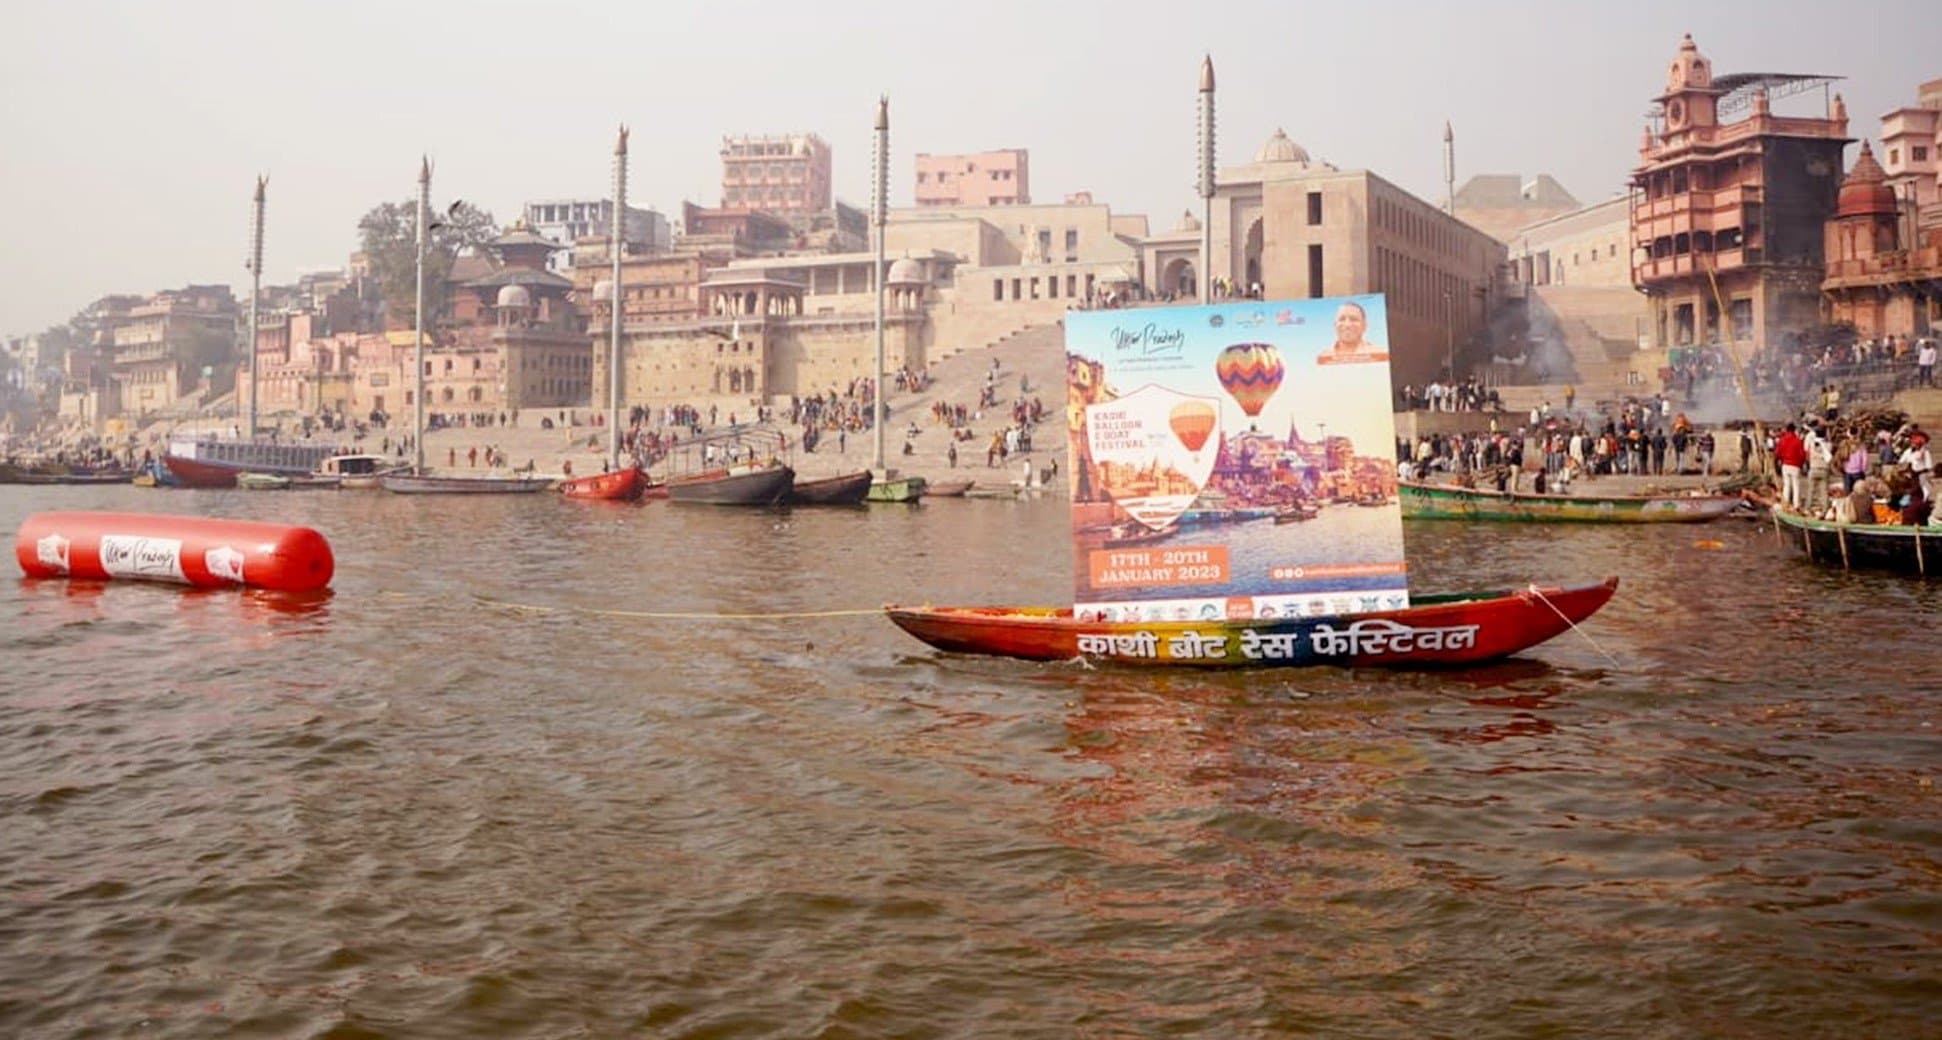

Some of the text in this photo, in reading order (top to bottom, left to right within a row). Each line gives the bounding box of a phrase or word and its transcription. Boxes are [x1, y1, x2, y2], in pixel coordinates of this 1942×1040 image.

[1143, 323, 1185, 354] Pradesh
[1095, 440, 1145, 449] FESTIVAL
[1110, 553, 1150, 567] 17TH
[1163, 551, 1208, 565] 20TH
[1099, 565, 1221, 583] JANUARY 2023
[1076, 619, 1480, 659] काशी बोट रेस फेस्टिवल
